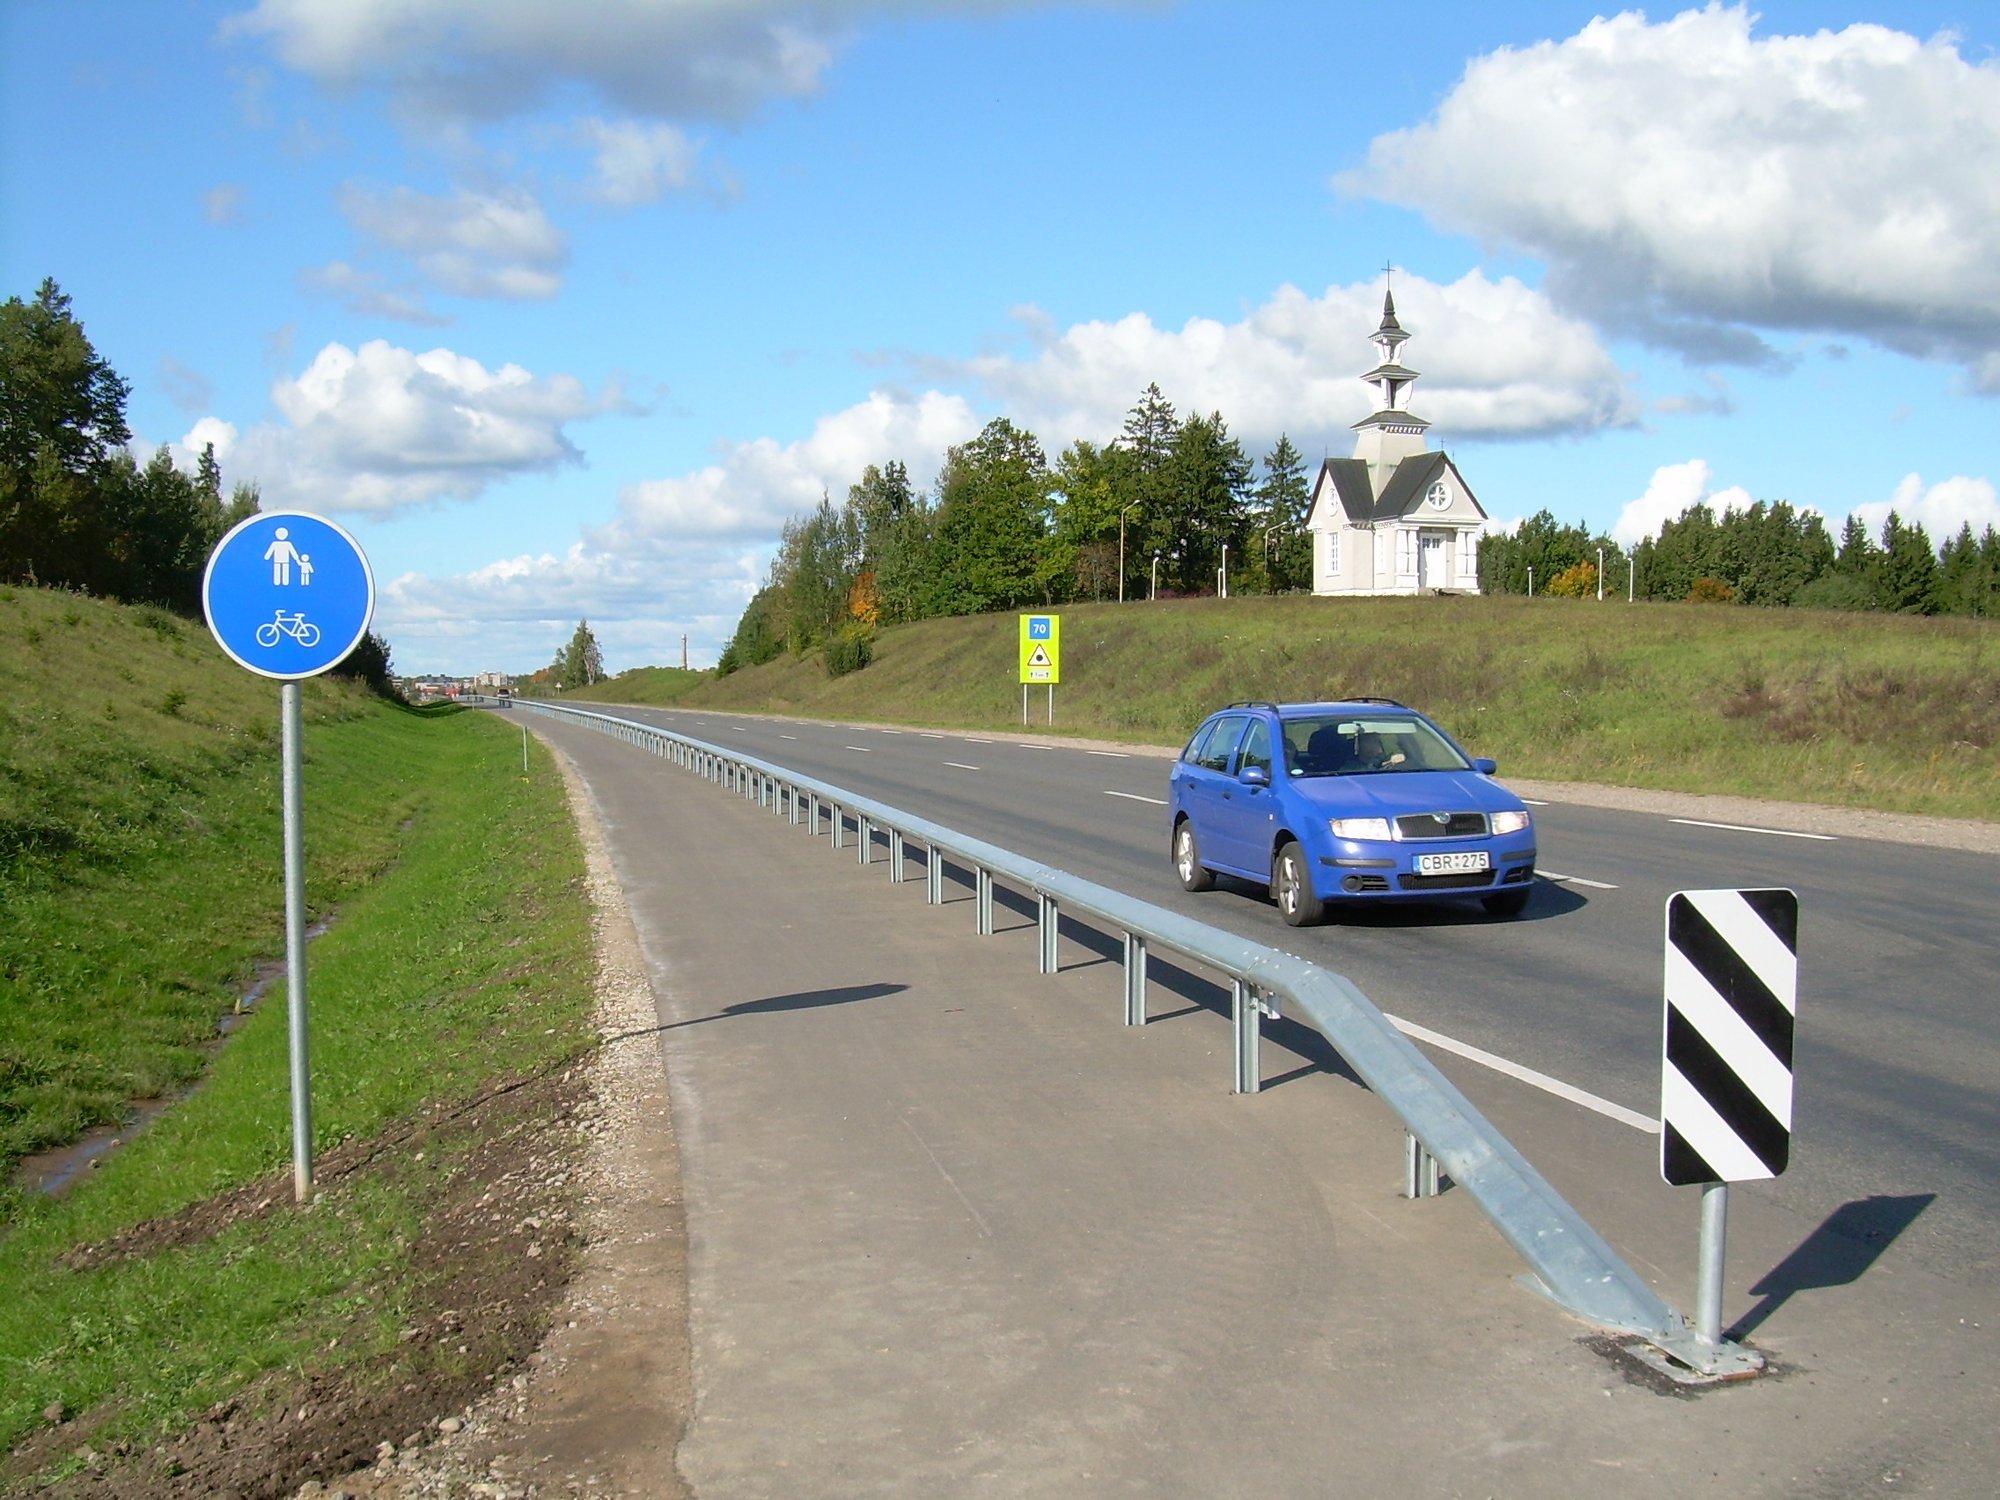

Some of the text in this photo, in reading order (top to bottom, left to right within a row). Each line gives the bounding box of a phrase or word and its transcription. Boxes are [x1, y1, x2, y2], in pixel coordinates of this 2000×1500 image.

[1033, 623, 1047, 634] 70
[1422, 853, 1487, 870] CBR 275
